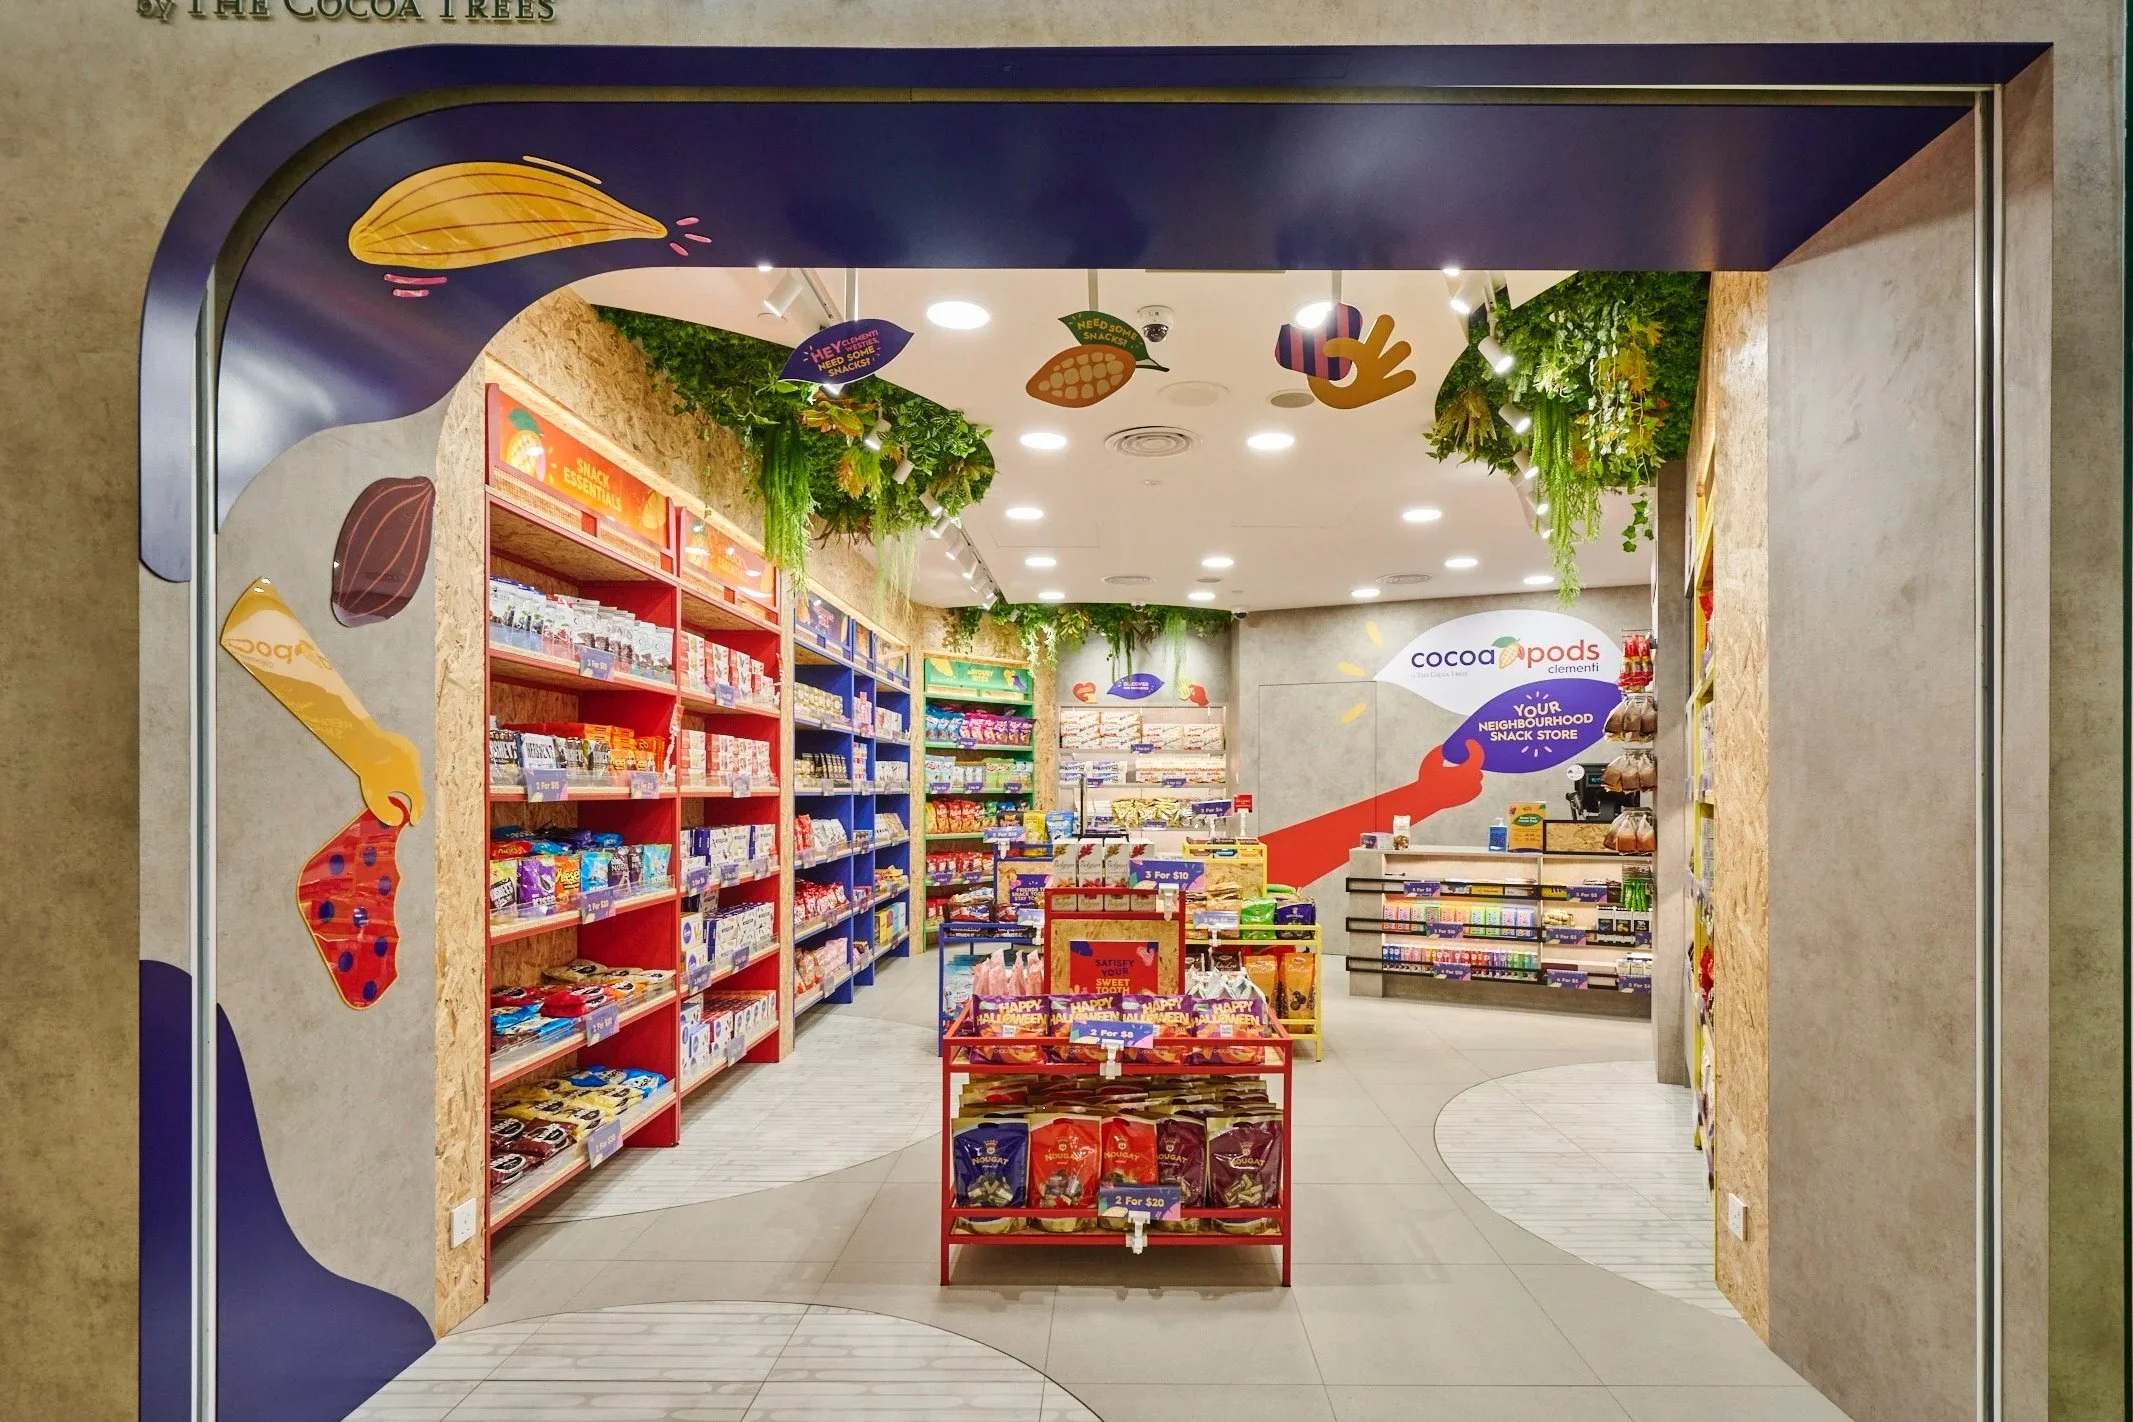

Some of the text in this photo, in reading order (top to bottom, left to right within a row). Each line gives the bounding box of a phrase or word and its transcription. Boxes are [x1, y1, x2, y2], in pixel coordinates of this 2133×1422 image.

[1077, 318, 1138, 341] NEED SOME
[810, 329, 879, 364] HEY CLEMENTI
[818, 345, 875, 371] NEED SOME
[576, 457, 611, 491] SNACK
[563, 466, 623, 513] ESSENTIALS
[1411, 639, 1600, 668] cocoa pods
[1548, 662, 1599, 674] clementi
[1513, 701, 1562, 718] YOUR
[1478, 713, 1594, 732] NEIGHBOURHOOD
[1490, 729, 1578, 741] SNACK STORE
[541, 781, 550, 790] For
[1145, 871, 1188, 880] 3 For $10
[1102, 968, 1129, 977] YOUR
[1096, 978, 1130, 986] SWEET
[999, 999, 1042, 1013] HAPPY
[1070, 997, 1114, 1013] HAPPY
[1142, 996, 1184, 1013] HAPPY
[1212, 1001, 1254, 1014] HAPPY
[1100, 1029, 1118, 1037] For
[972, 1156, 1009, 1166] NOUGAT
[1104, 1152, 1140, 1161] NOUGAT
[1158, 1153, 1188, 1163] OUGAT
[1115, 1196, 1164, 1207] 2 For $20
